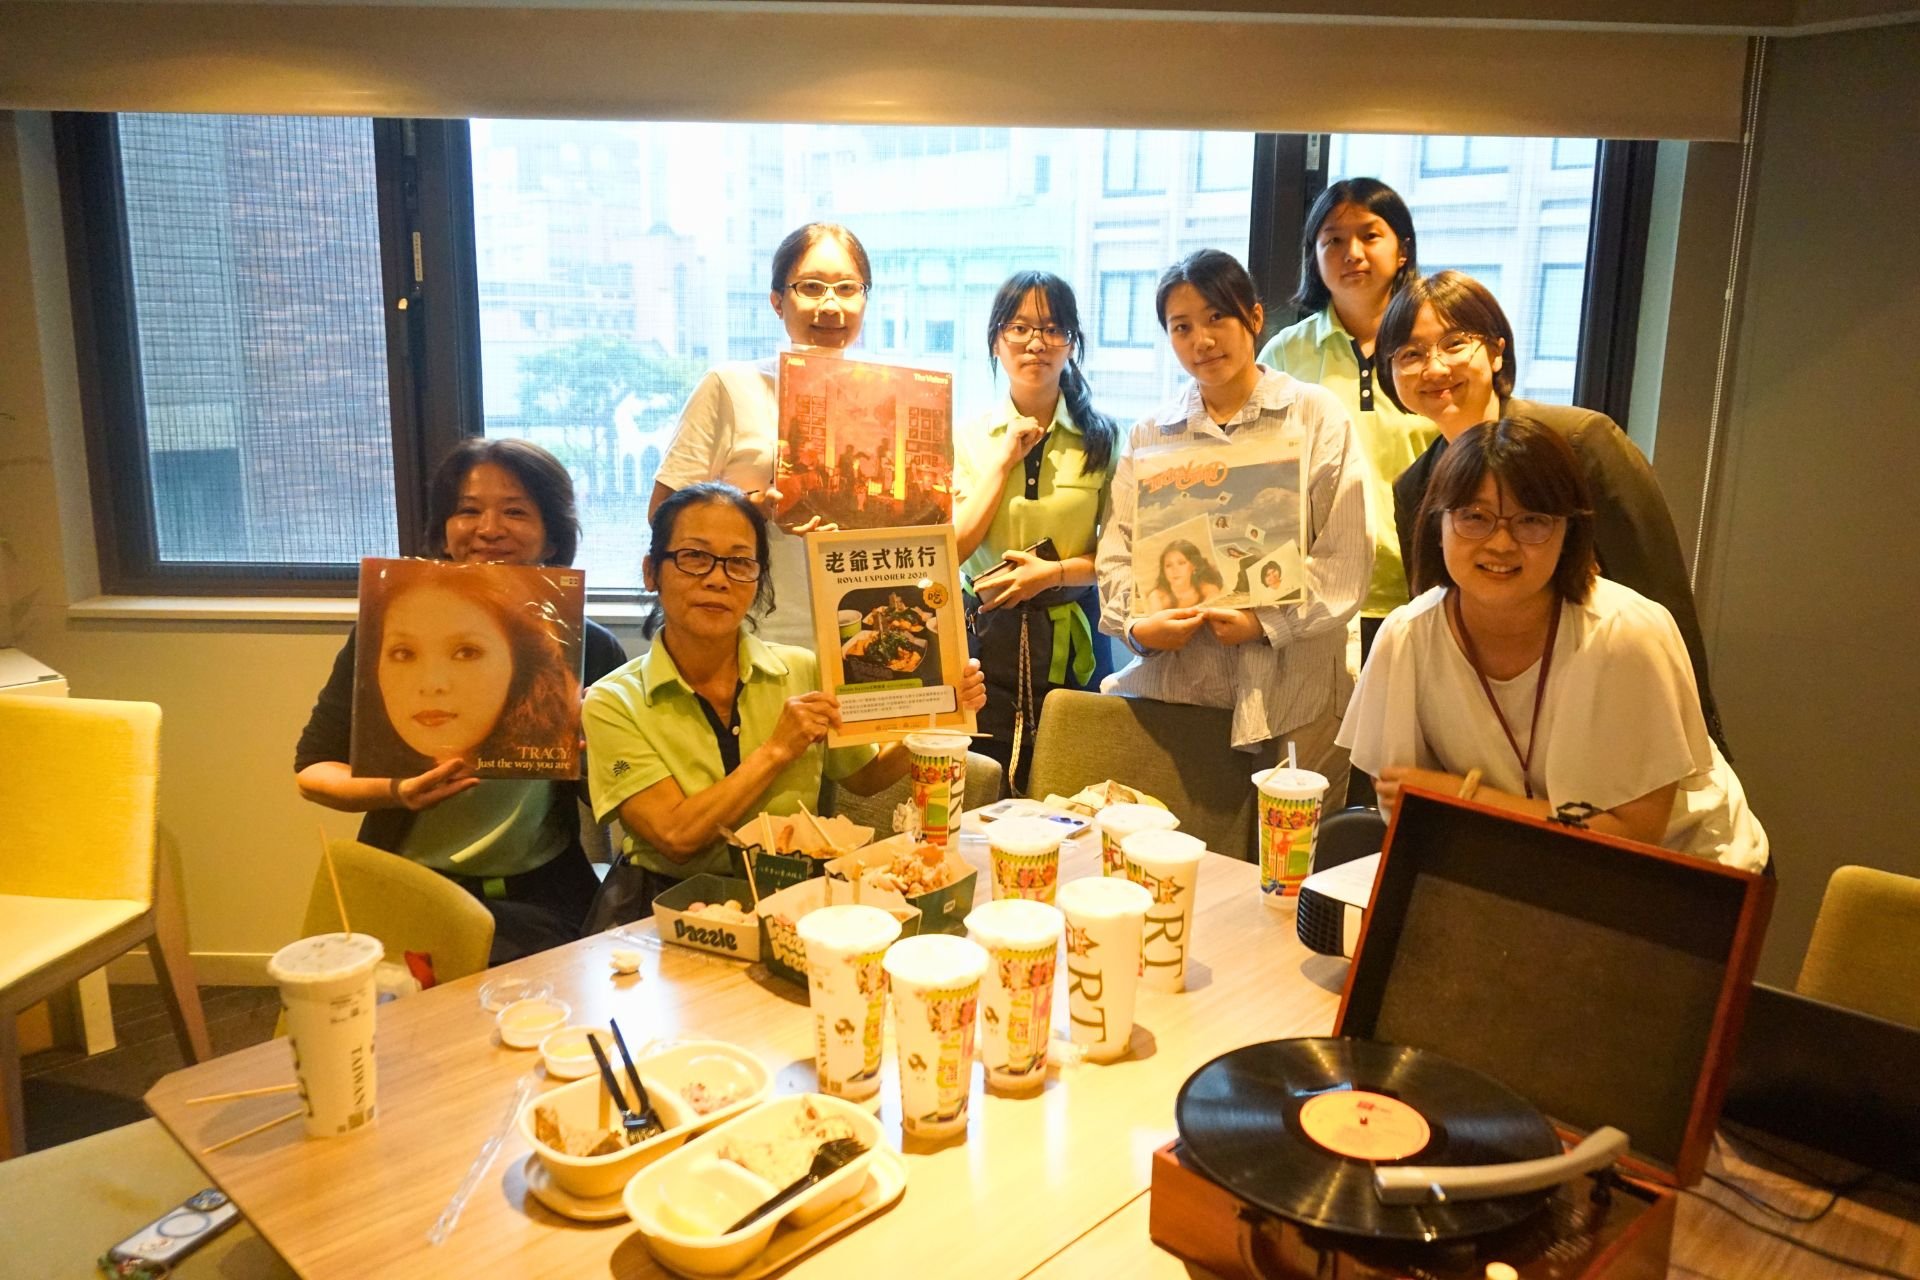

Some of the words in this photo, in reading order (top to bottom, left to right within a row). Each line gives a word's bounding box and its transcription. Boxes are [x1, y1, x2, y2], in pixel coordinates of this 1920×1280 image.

[826, 546, 936, 573] 老爺式旅行
[837, 575, 863, 584] ROYAL
[865, 573, 905, 583] EXPLORER
[517, 746, 568, 760] TRACY
[476, 758, 495, 770] Just
[497, 758, 513, 769] the
[515, 761, 534, 771] way
[536, 761, 553, 771] you
[555, 761, 570, 769] are
[674, 918, 738, 951] Dazzle
[351, 1045, 366, 1106] TAIWAN
